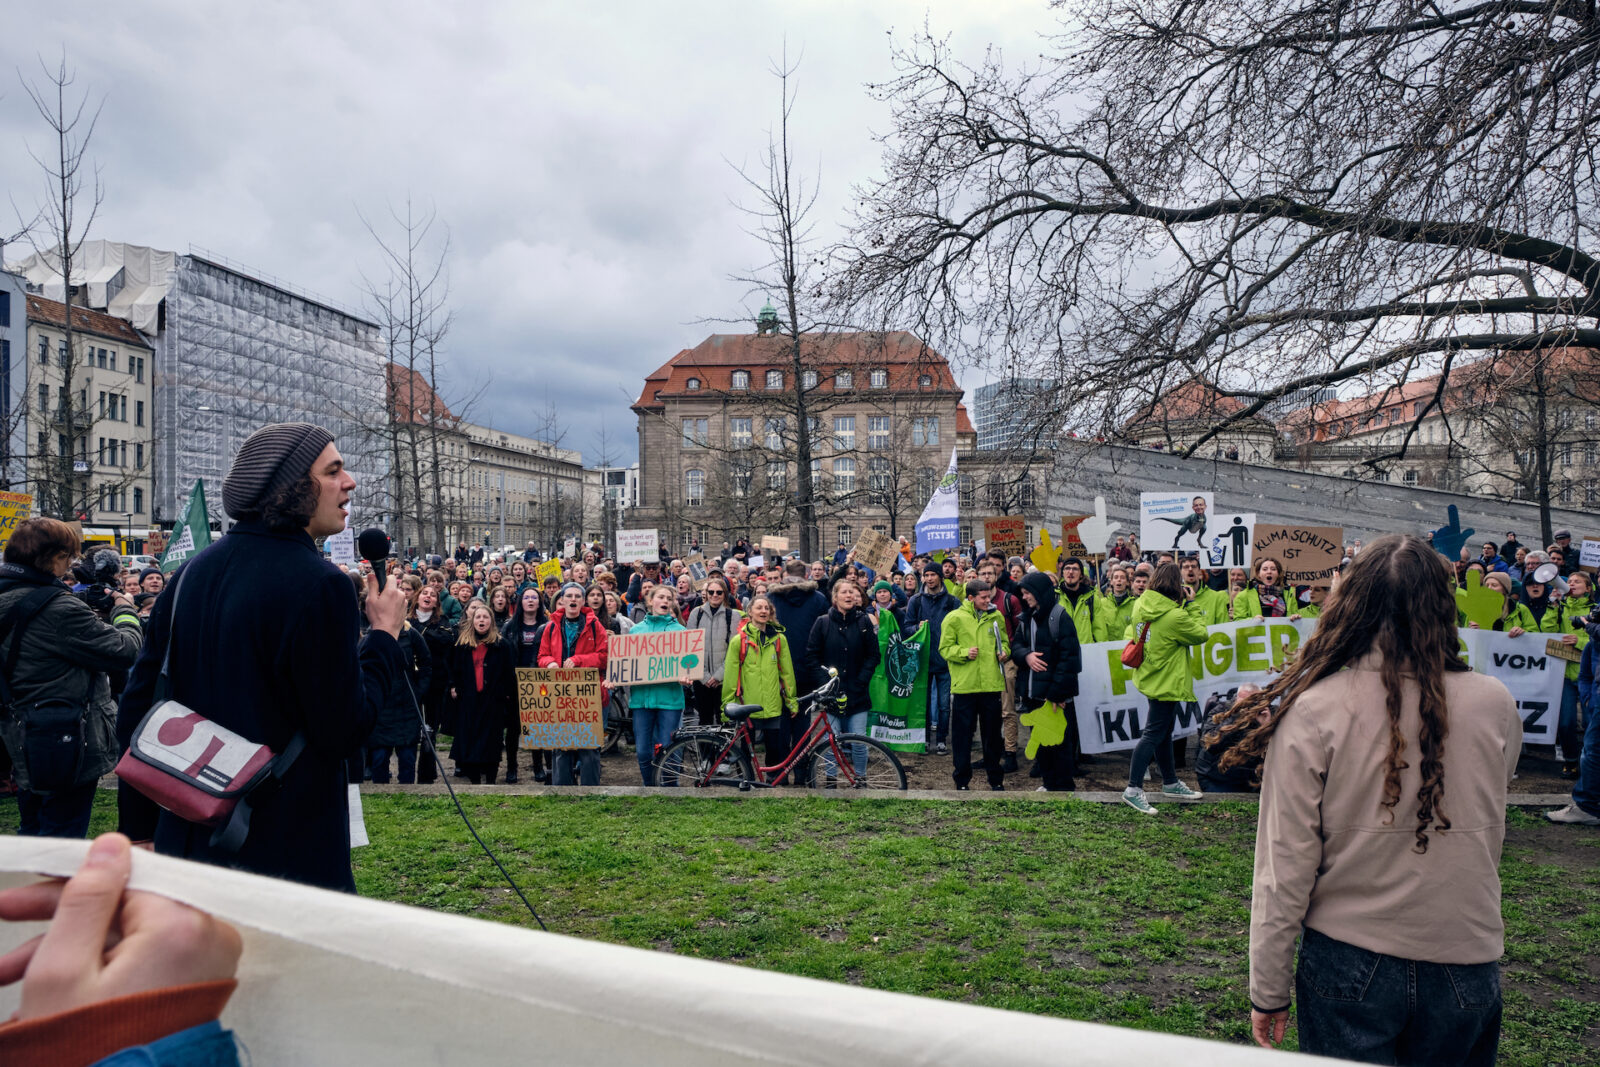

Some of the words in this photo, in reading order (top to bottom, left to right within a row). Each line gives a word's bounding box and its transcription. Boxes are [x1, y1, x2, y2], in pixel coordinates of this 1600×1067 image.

[1283, 548, 1302, 559] IST
[610, 629, 703, 658] KLIMASCHUTZ
[1493, 652, 1547, 671] VOM
[518, 670, 551, 682] DEINE
[555, 670, 581, 682] MUM
[584, 670, 597, 682] IST
[609, 658, 643, 683] WEIL
[648, 655, 679, 681] BAUM
[520, 683, 534, 696] SO
[576, 684, 597, 697] HAT
[520, 696, 551, 710] BALD
[556, 696, 596, 709] BREN-
[520, 710, 555, 724] NENDE
[522, 725, 530, 736] &
[529, 722, 593, 736] STEIGENDE
